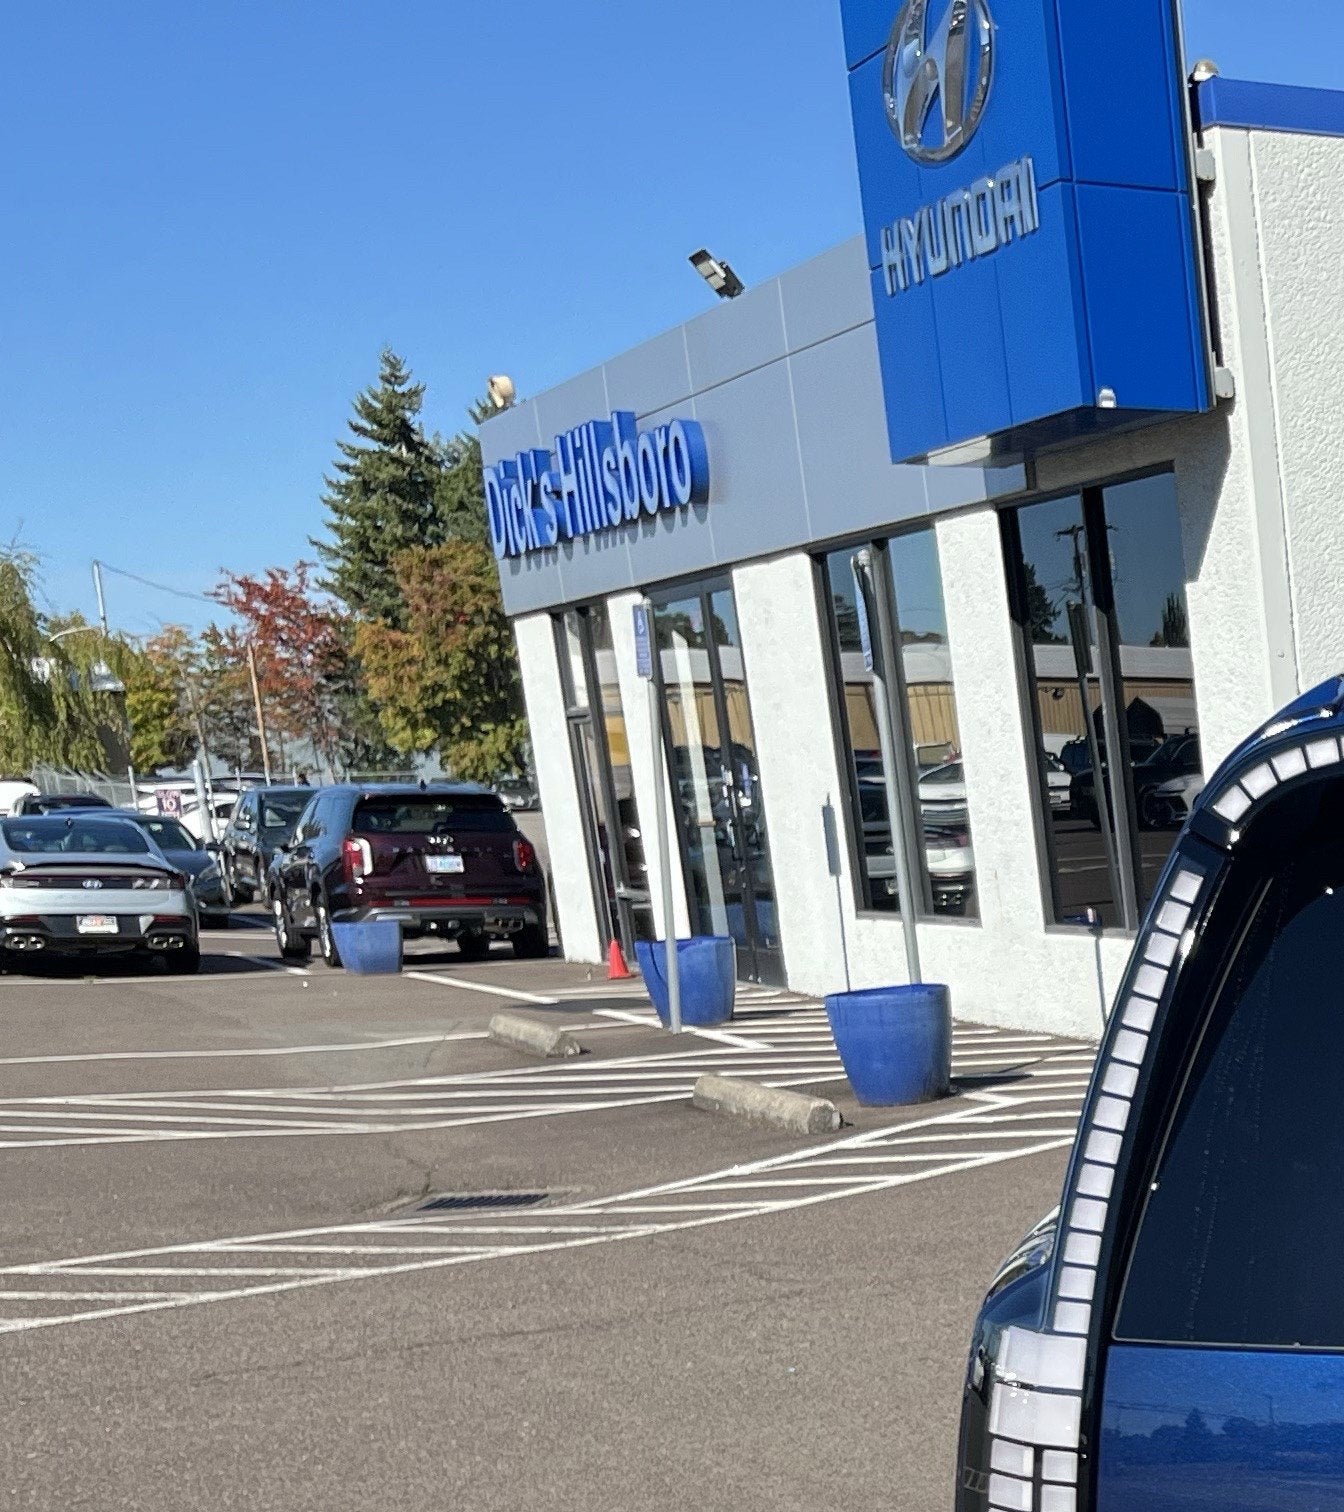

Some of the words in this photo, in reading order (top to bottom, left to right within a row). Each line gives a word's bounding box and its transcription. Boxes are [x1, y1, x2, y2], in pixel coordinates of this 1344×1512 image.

[880, 155, 1039, 297] HYUNDAI
[484, 450, 557, 560] Dick's
[555, 411, 702, 538] Hillsboro
